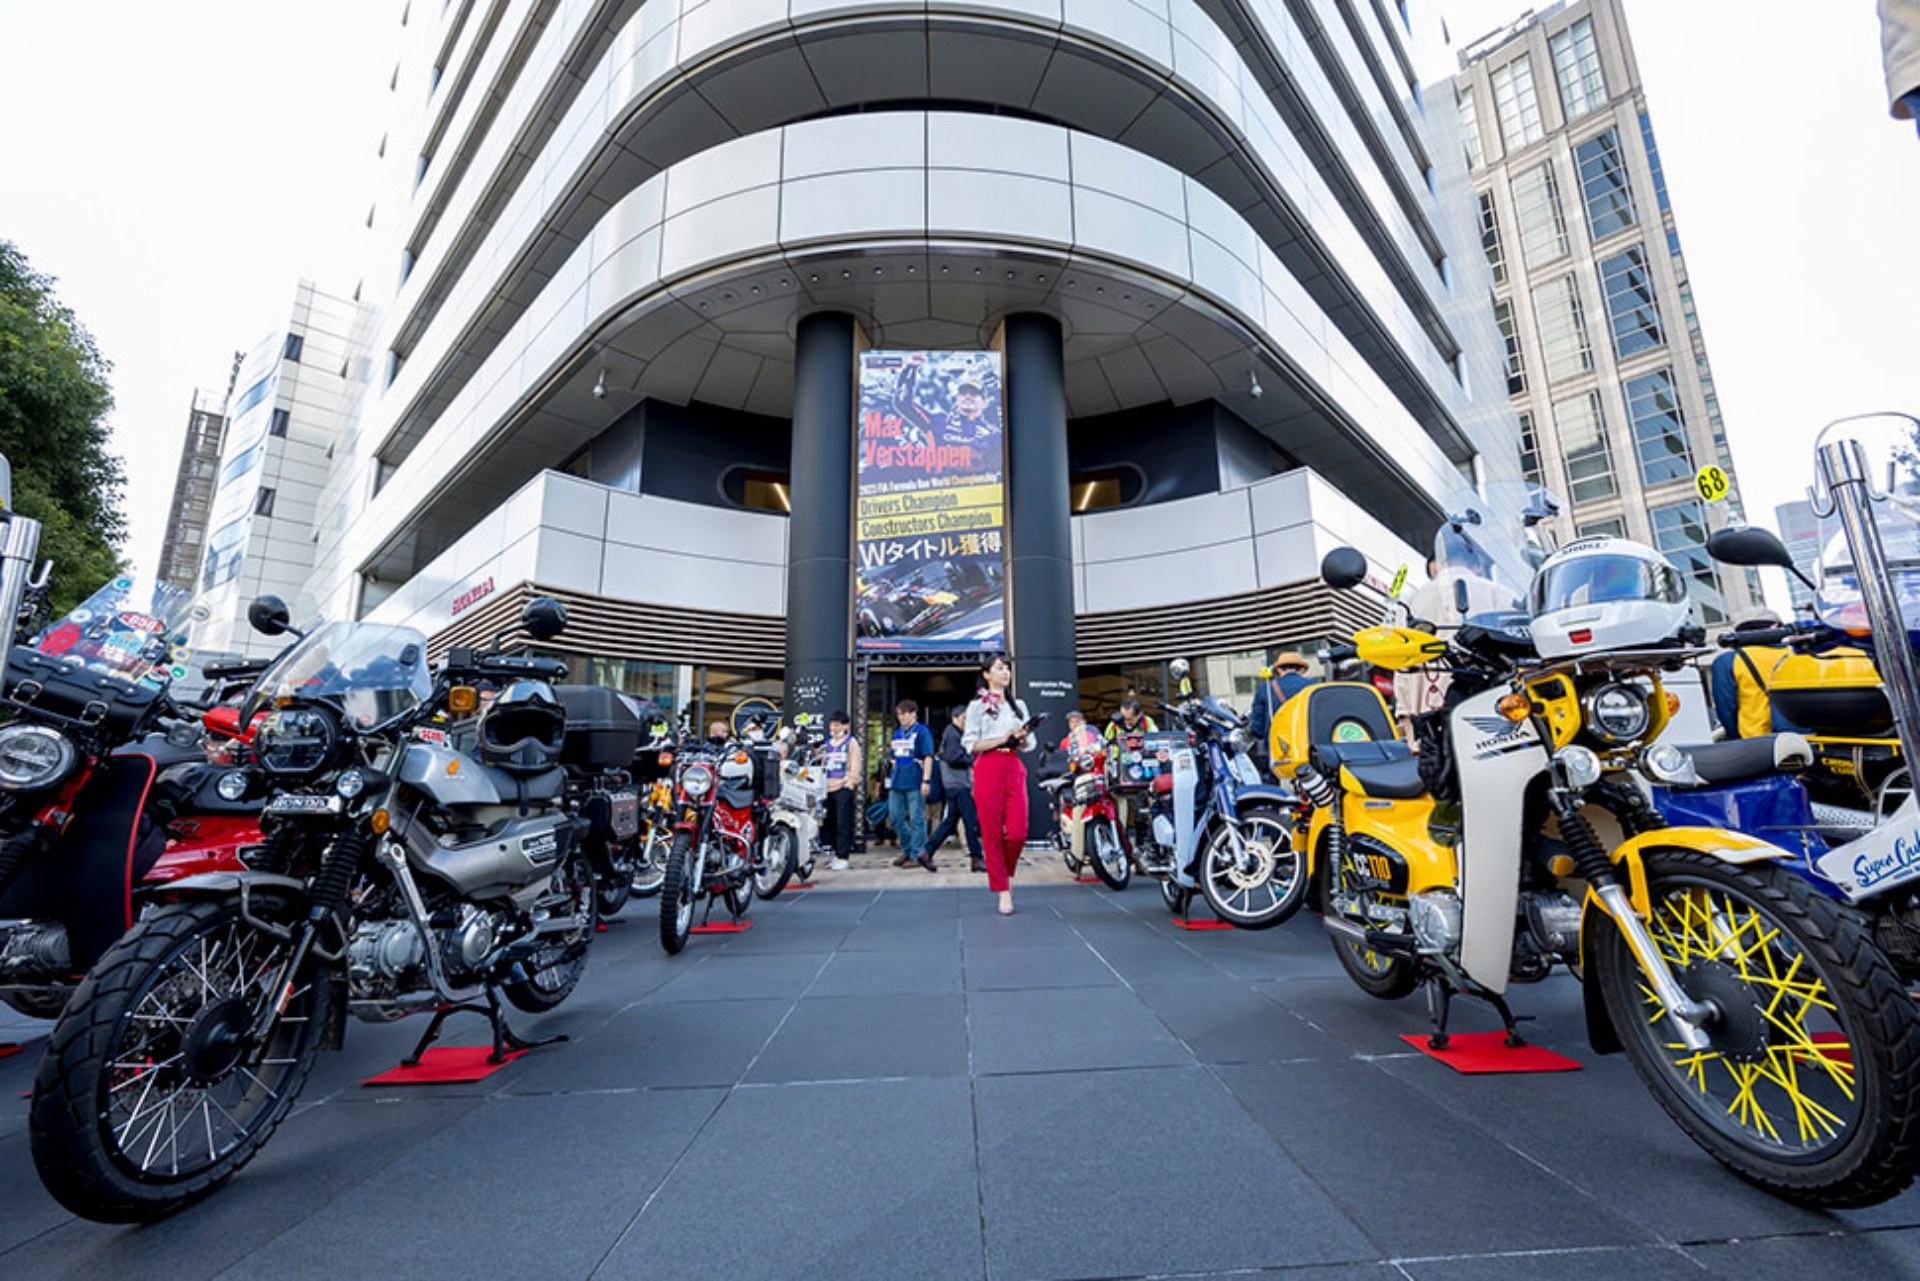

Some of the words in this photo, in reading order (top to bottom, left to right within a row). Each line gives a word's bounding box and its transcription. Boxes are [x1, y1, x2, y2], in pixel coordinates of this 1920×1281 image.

[864, 411, 903, 438] Max
[864, 441, 972, 473] Verstappen
[931, 476, 951, 488] World
[1698, 467, 1725, 499] 68
[861, 499, 901, 516] Drivers
[902, 491, 958, 511] Champion
[862, 516, 936, 537] Constructors
[936, 510, 992, 530] Champion
[858, 531, 1002, 569] Wタイトル獲得
[793, 714, 824, 725] CFE
[1475, 731, 1531, 749] HONDA
[272, 797, 328, 808] HONDA
